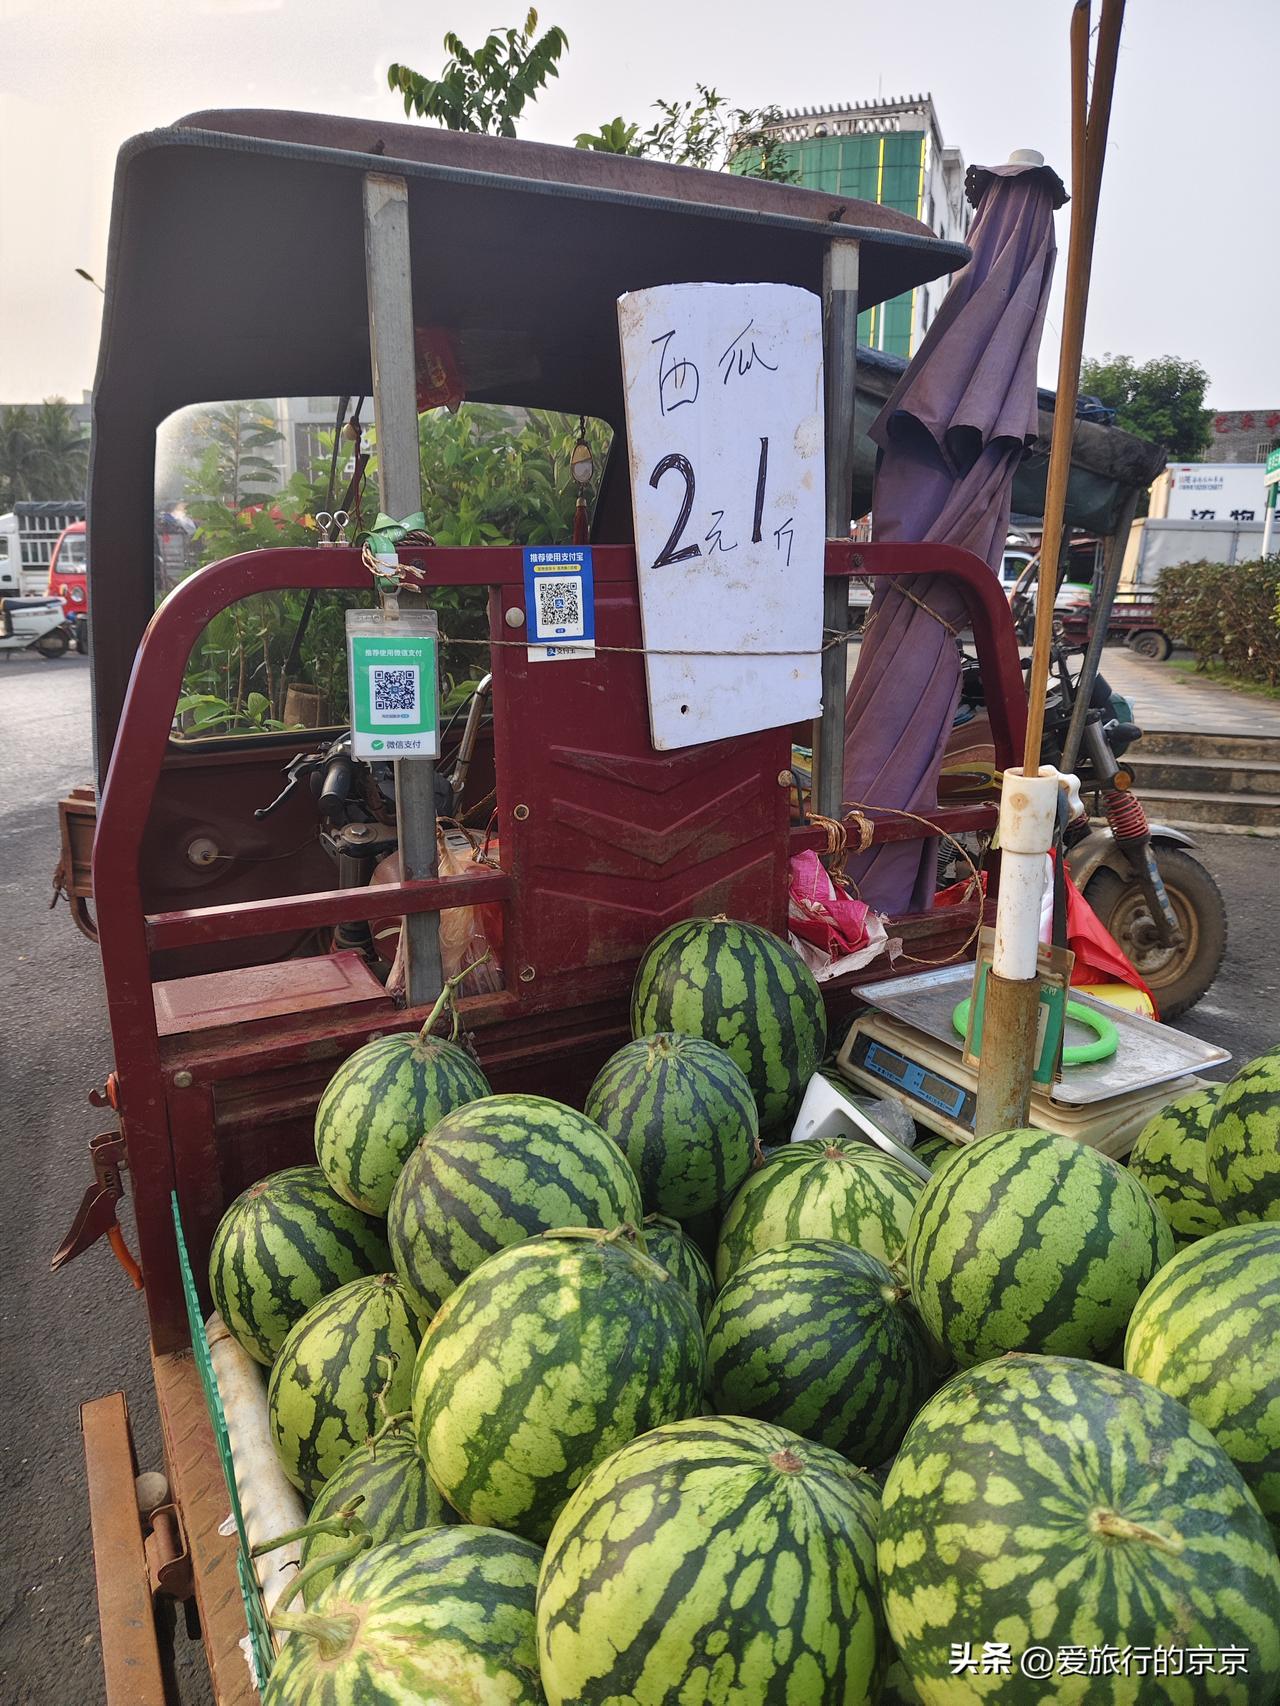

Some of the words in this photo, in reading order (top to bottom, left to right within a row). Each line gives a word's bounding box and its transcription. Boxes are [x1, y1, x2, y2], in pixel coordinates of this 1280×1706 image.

[651, 319, 778, 416] 西瓜
[530, 552, 584, 563] 推荐使用支付宝
[365, 648, 422, 657] 推荐使用微信支付
[386, 740, 421, 749] 微信支付
